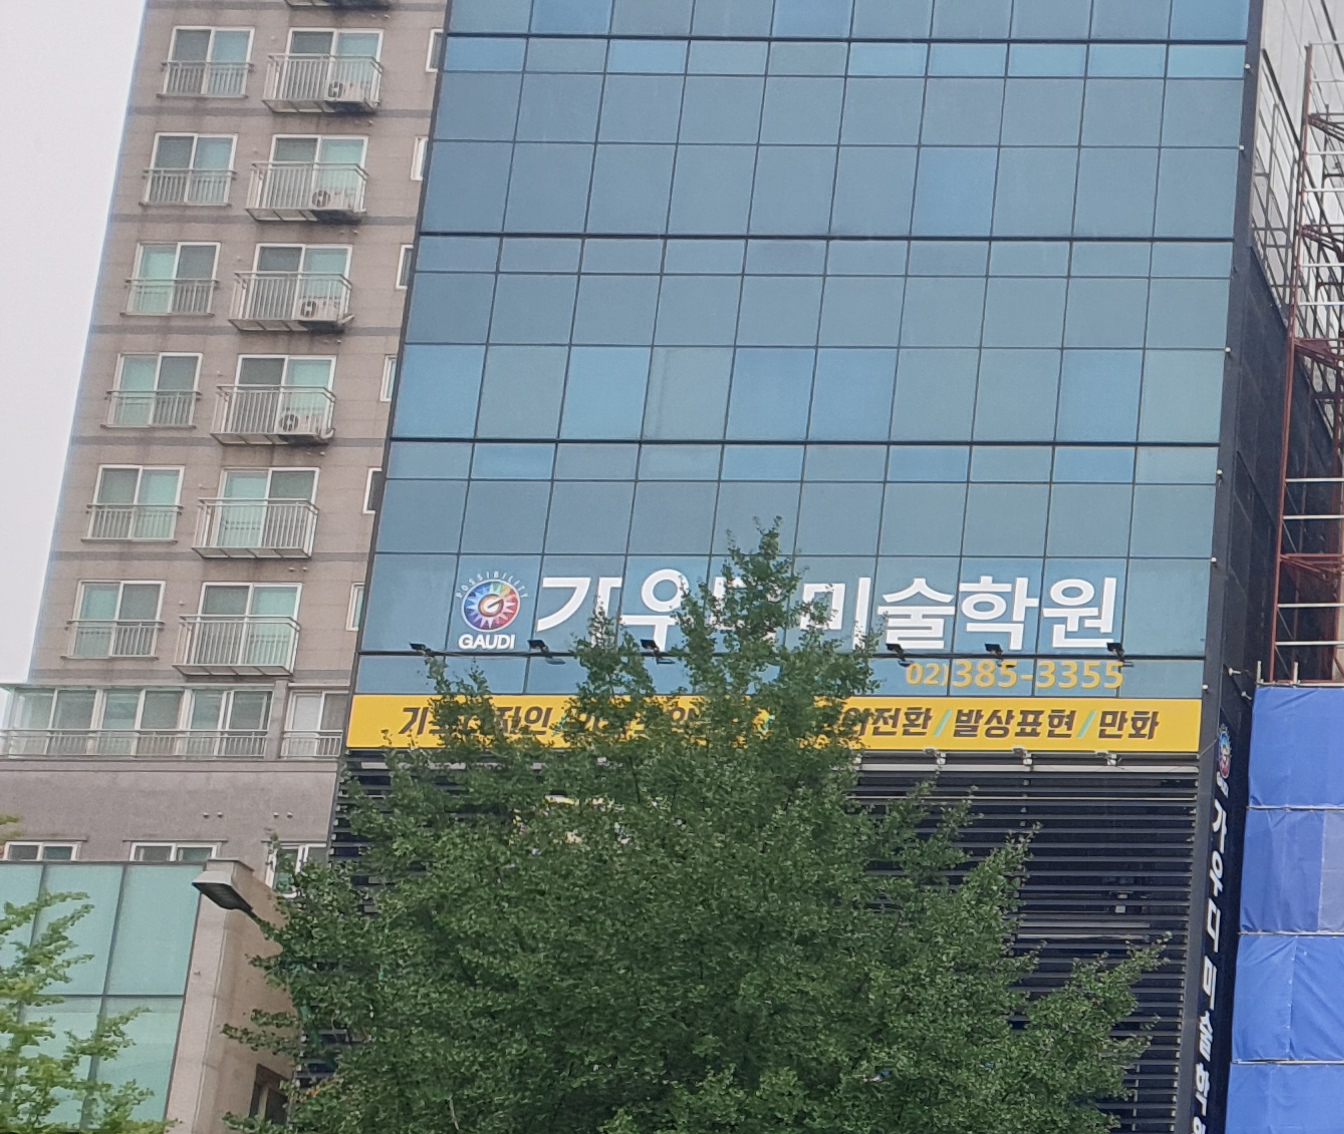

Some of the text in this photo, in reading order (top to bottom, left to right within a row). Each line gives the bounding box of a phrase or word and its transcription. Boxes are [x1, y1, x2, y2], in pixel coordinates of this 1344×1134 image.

[458, 634, 516, 650] GAUDI
[953, 708, 1077, 739] 발상표현
[1098, 710, 1160, 740] 만화
